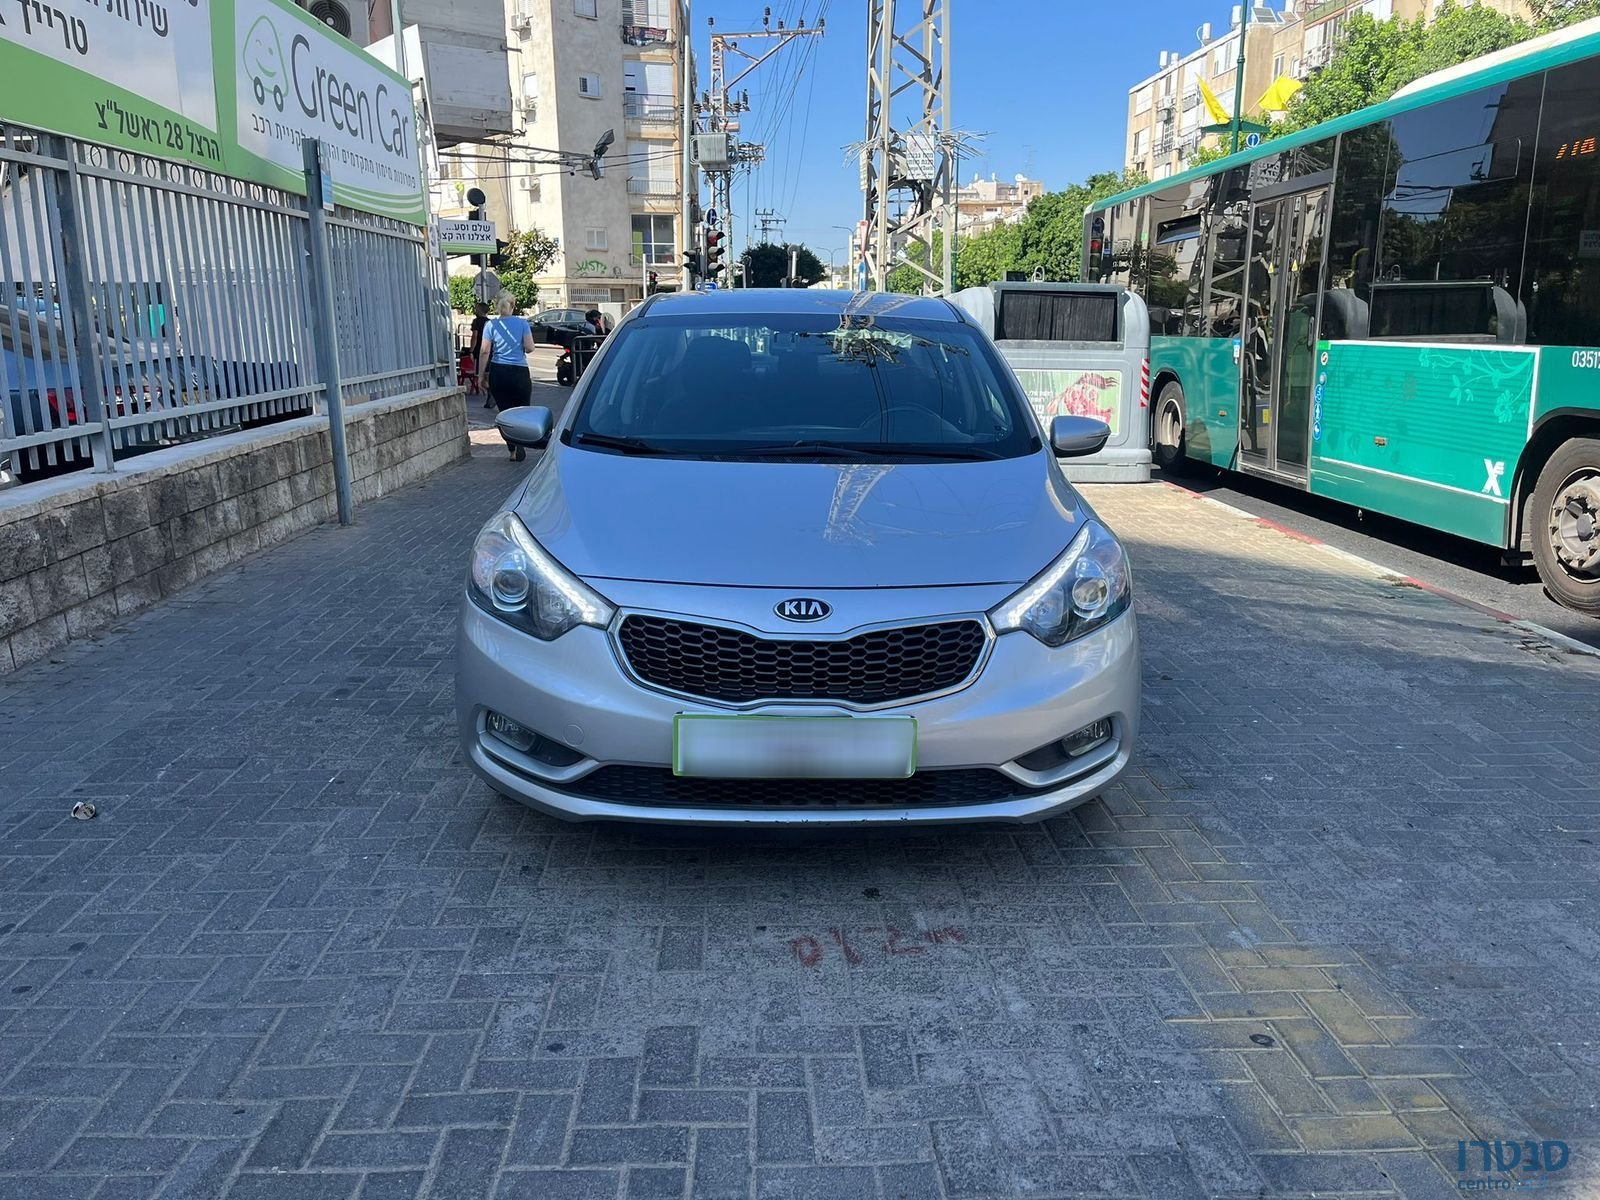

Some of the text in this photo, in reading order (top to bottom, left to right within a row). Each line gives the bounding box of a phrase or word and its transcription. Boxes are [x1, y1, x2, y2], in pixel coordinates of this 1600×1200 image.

[291, 34, 409, 160] Green Car
[164, 119, 184, 150] 28
[251, 113, 272, 137] רכב
[186, 124, 221, 162] הרצל
[456, 232, 465, 240] זה
[468, 232, 491, 241] אצלנו
[472, 223, 491, 233] שלם
[784, 601, 824, 616] KIA
